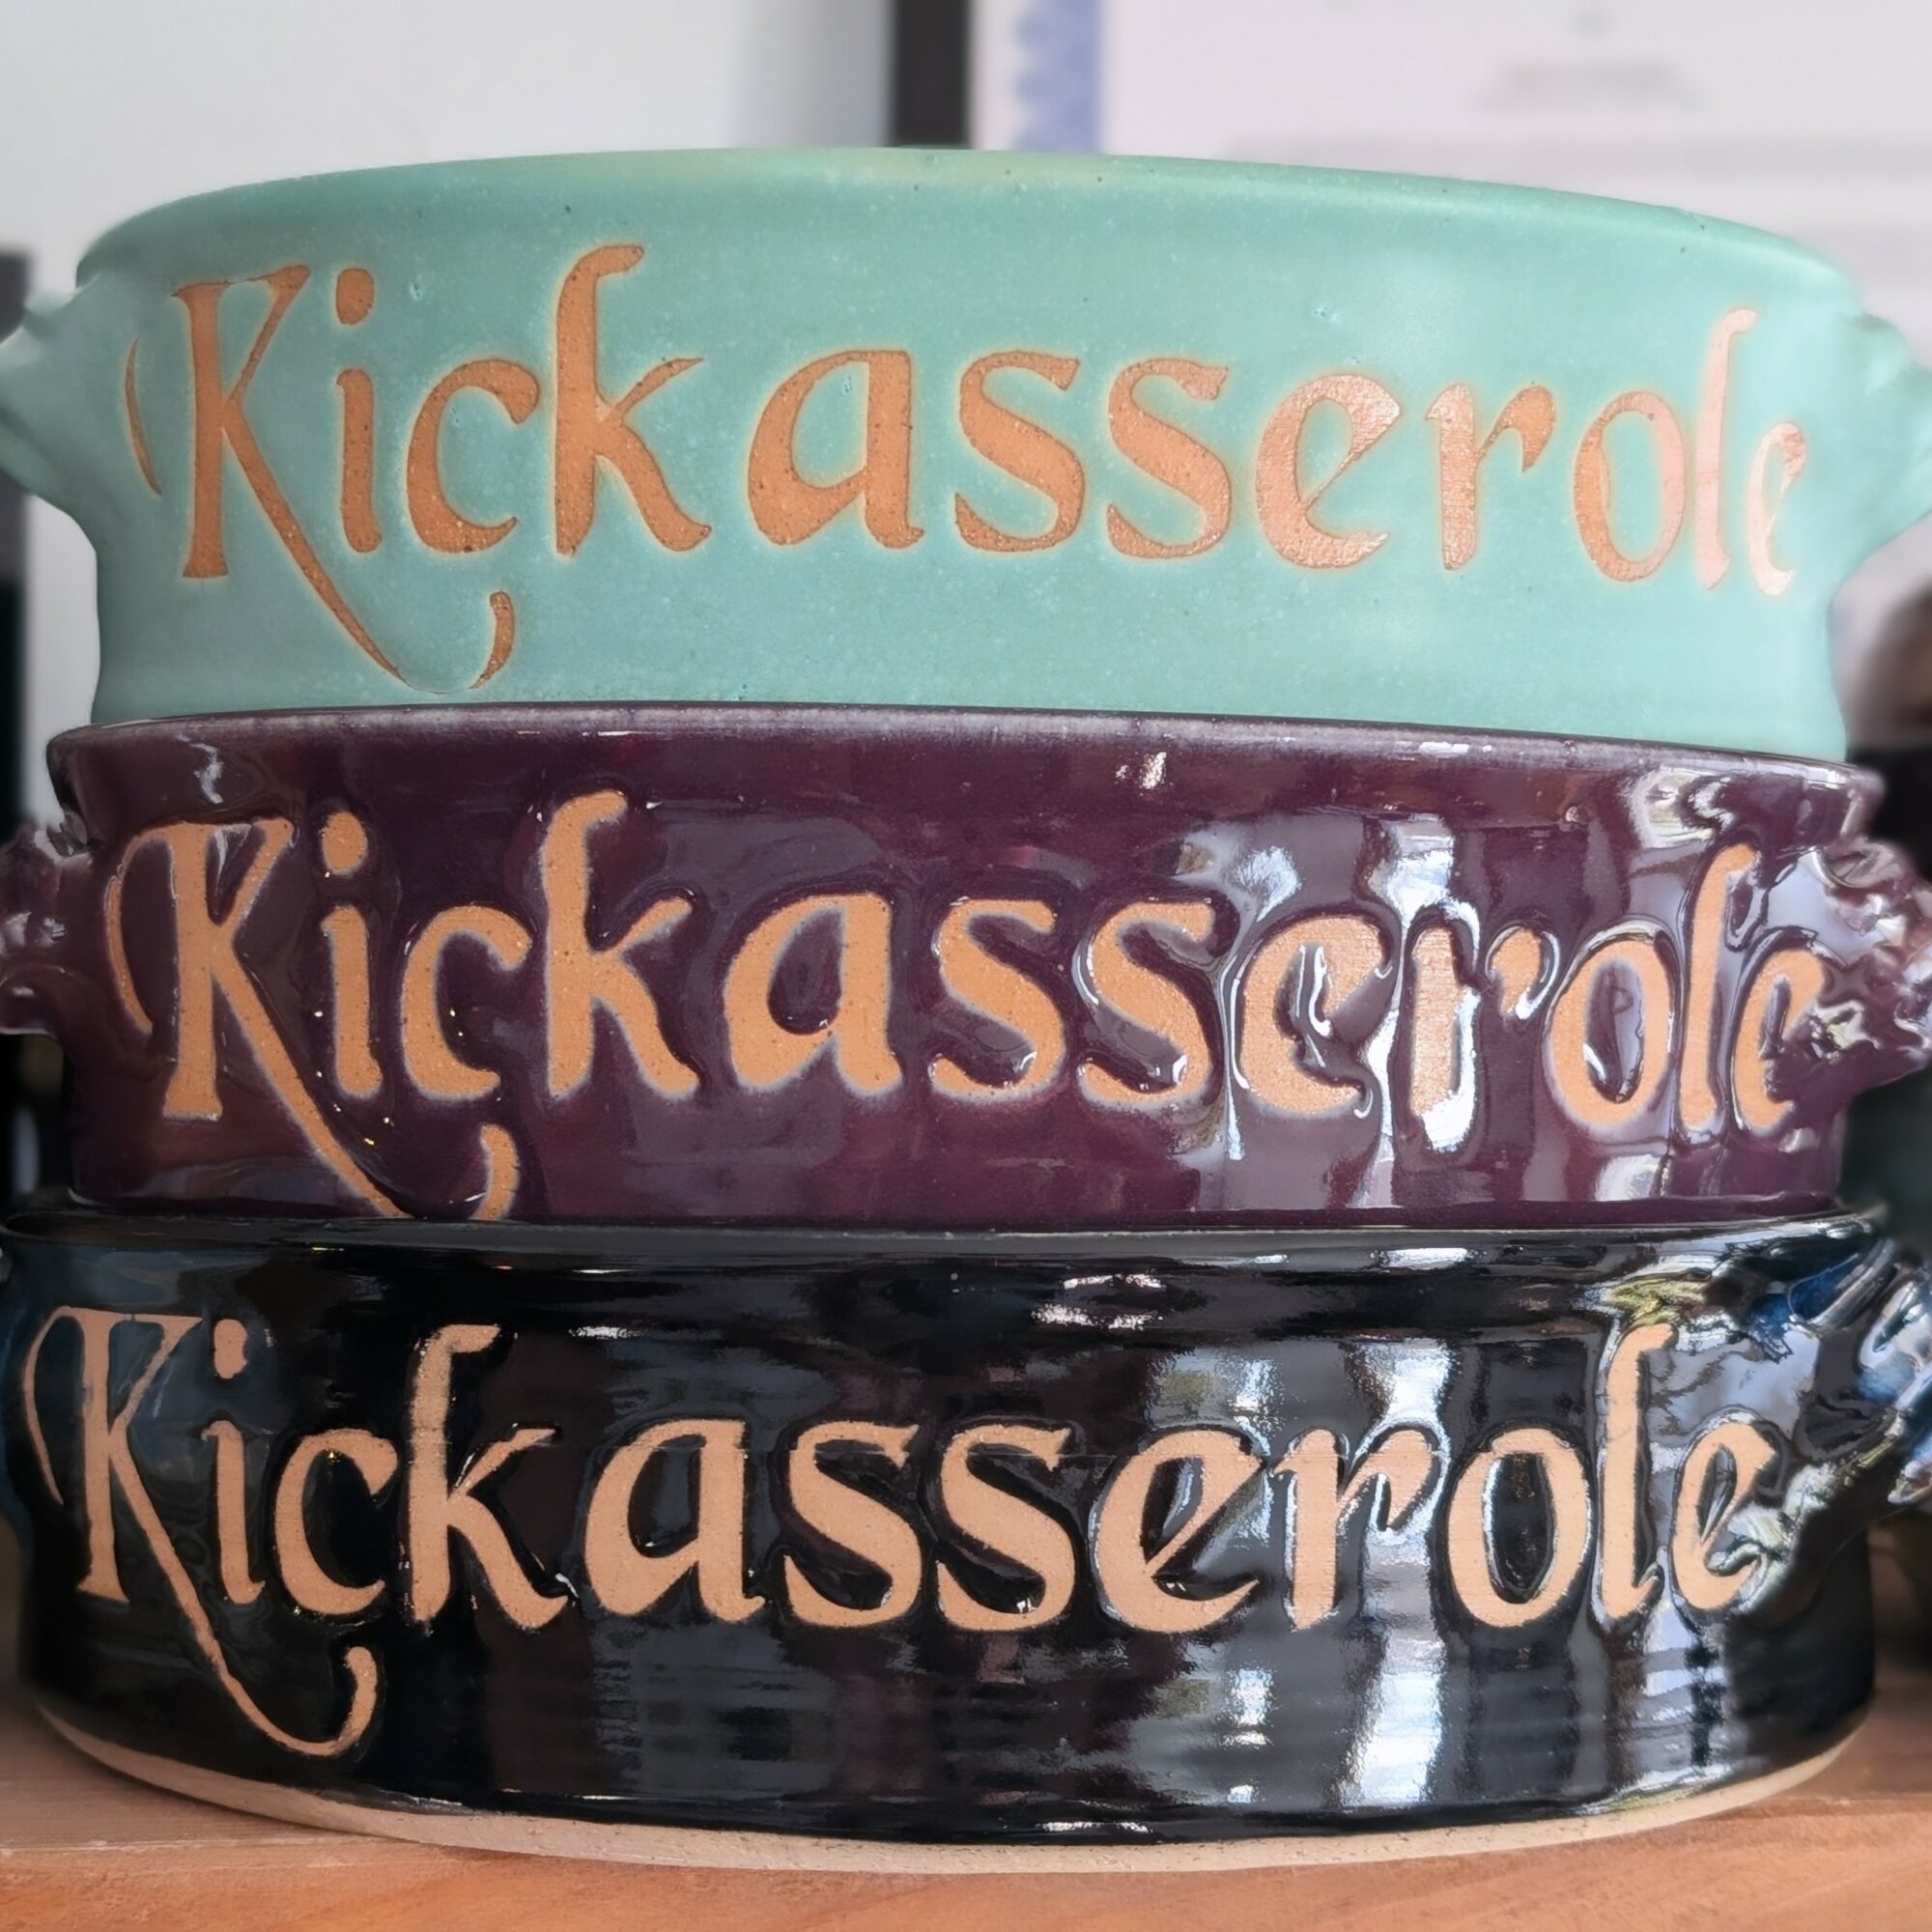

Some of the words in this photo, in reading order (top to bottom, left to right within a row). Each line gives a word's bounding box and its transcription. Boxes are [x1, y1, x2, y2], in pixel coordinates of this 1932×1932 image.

[125, 243, 1808, 695] Kickasserole
[104, 788, 1832, 1219] Kickasserole
[22, 1304, 1776, 1757] Kickasserole
